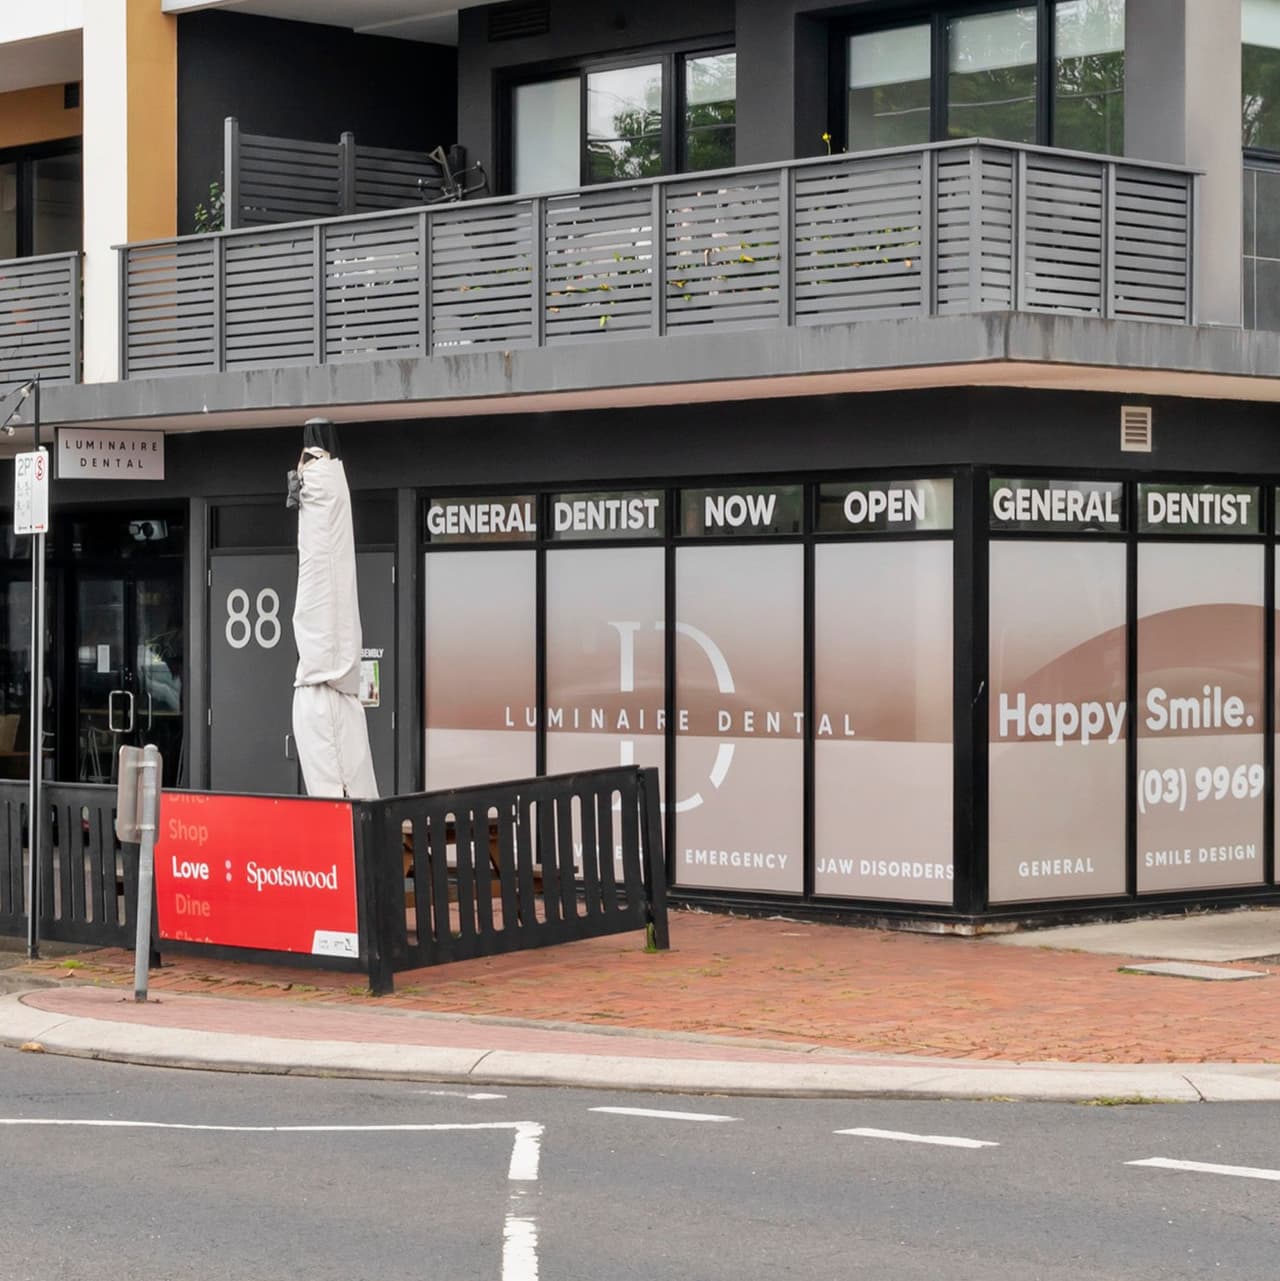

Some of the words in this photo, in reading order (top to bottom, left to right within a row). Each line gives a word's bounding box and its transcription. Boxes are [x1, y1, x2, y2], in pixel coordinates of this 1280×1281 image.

[65, 439, 158, 452] LUMINAIRE
[80, 457, 144, 469] DENTAL
[426, 502, 537, 535] GENERAL
[554, 498, 660, 531] DENTIST
[704, 493, 777, 528] NOW
[843, 488, 926, 524] OPEN
[992, 487, 1120, 523] GENERAL
[1146, 491, 1252, 525] DENTIST
[225, 587, 282, 649] 88
[505, 706, 690, 731] LUMINAIRE
[718, 709, 855, 736] DENTAL
[999, 692, 1127, 747] Happy
[1146, 684, 1254, 731] Smile.
[1138, 767, 1188, 813] (03)
[1195, 763, 1264, 801] 9969
[168, 818, 209, 845] Shop
[684, 849, 788, 869] EMERGENCY
[1018, 857, 1095, 878] GENERAL
[1145, 847, 1191, 867] SMILE
[1199, 844, 1256, 863] DESIGN
[172, 855, 210, 880] Love
[246, 861, 338, 892] Spotswood
[817, 858, 853, 875] JAW
[860, 859, 954, 881] DISORDERS
[175, 893, 211, 917] Dine
